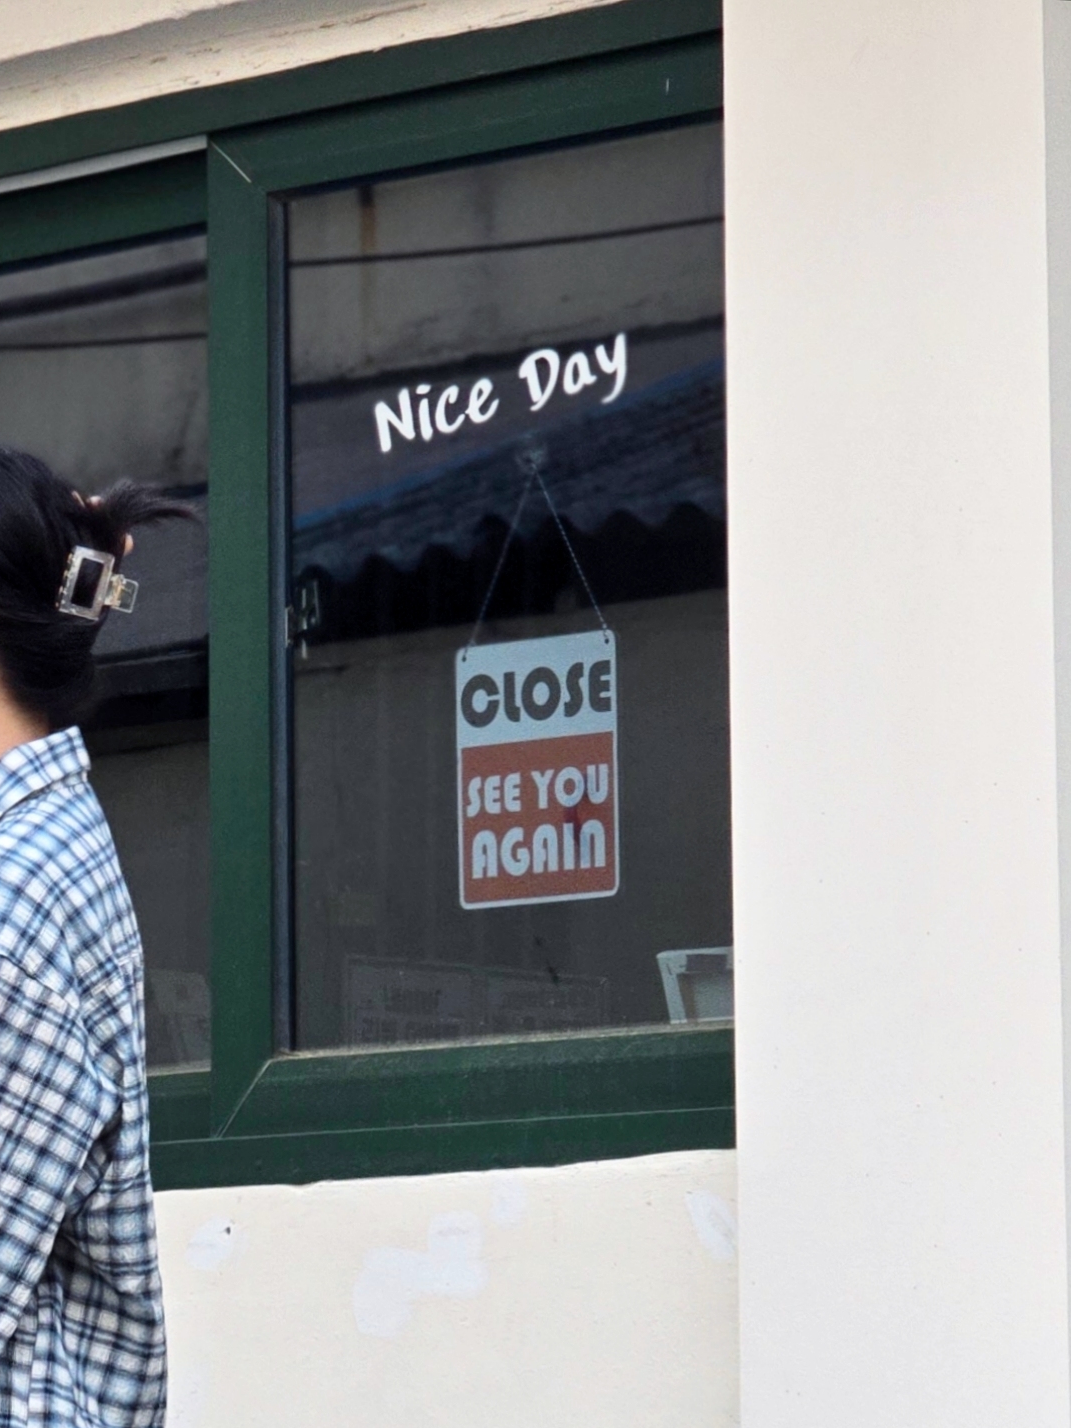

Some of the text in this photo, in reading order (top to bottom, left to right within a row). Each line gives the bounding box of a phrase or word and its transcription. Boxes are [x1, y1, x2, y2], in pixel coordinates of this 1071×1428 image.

[374, 332, 627, 453] Nice Day
[461, 659, 612, 728] CLOSE
[467, 764, 609, 816] SEE YOU
[472, 819, 606, 880] AGAIN
